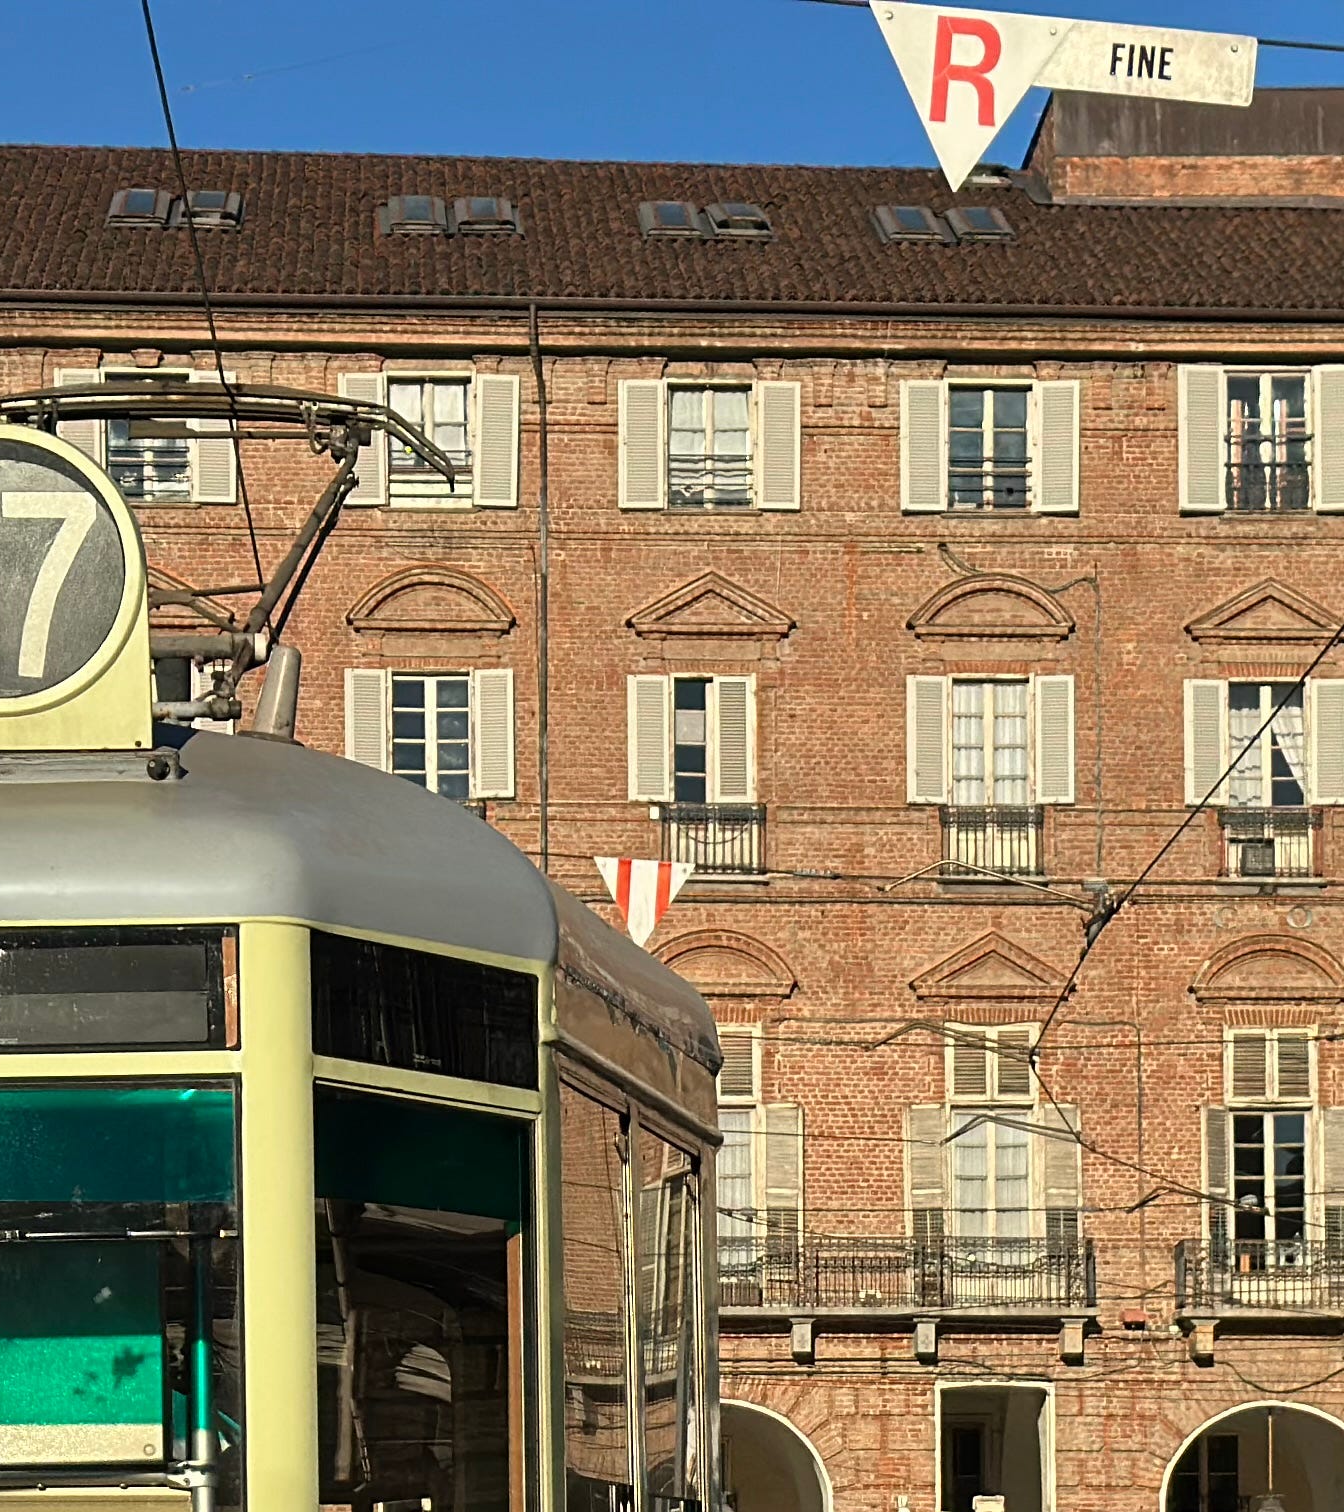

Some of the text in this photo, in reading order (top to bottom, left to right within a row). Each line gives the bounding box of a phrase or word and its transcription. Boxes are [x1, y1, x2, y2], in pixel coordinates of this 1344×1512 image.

[929, 15, 1002, 127] R
[1109, 43, 1175, 82] FINE
[1, 491, 96, 678] 7
